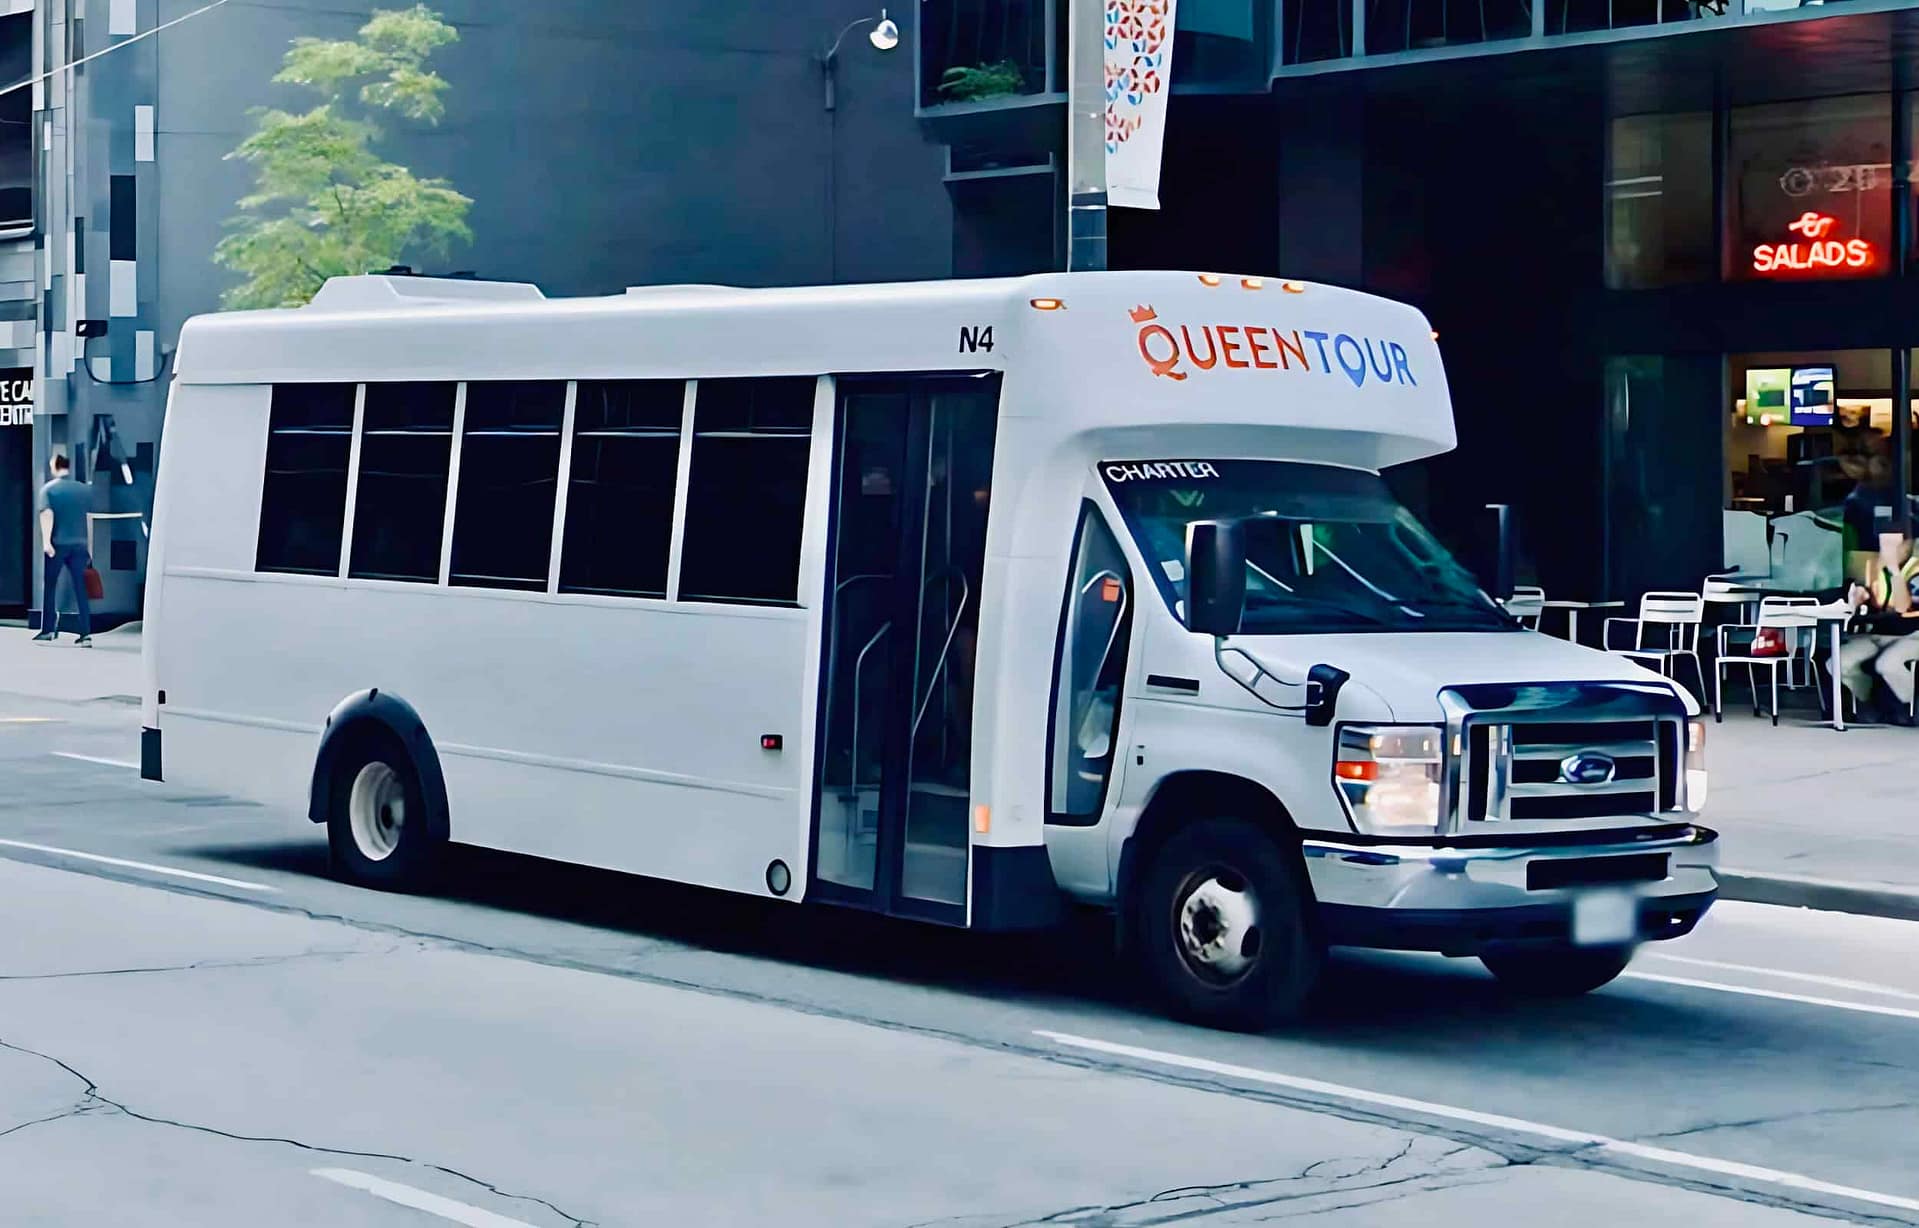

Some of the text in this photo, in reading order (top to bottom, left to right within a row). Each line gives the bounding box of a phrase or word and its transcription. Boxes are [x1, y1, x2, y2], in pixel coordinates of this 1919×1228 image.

[1752, 238, 1870, 272] SALADS
[959, 325, 994, 353] N4
[1105, 461, 1220, 482] CHARTER
